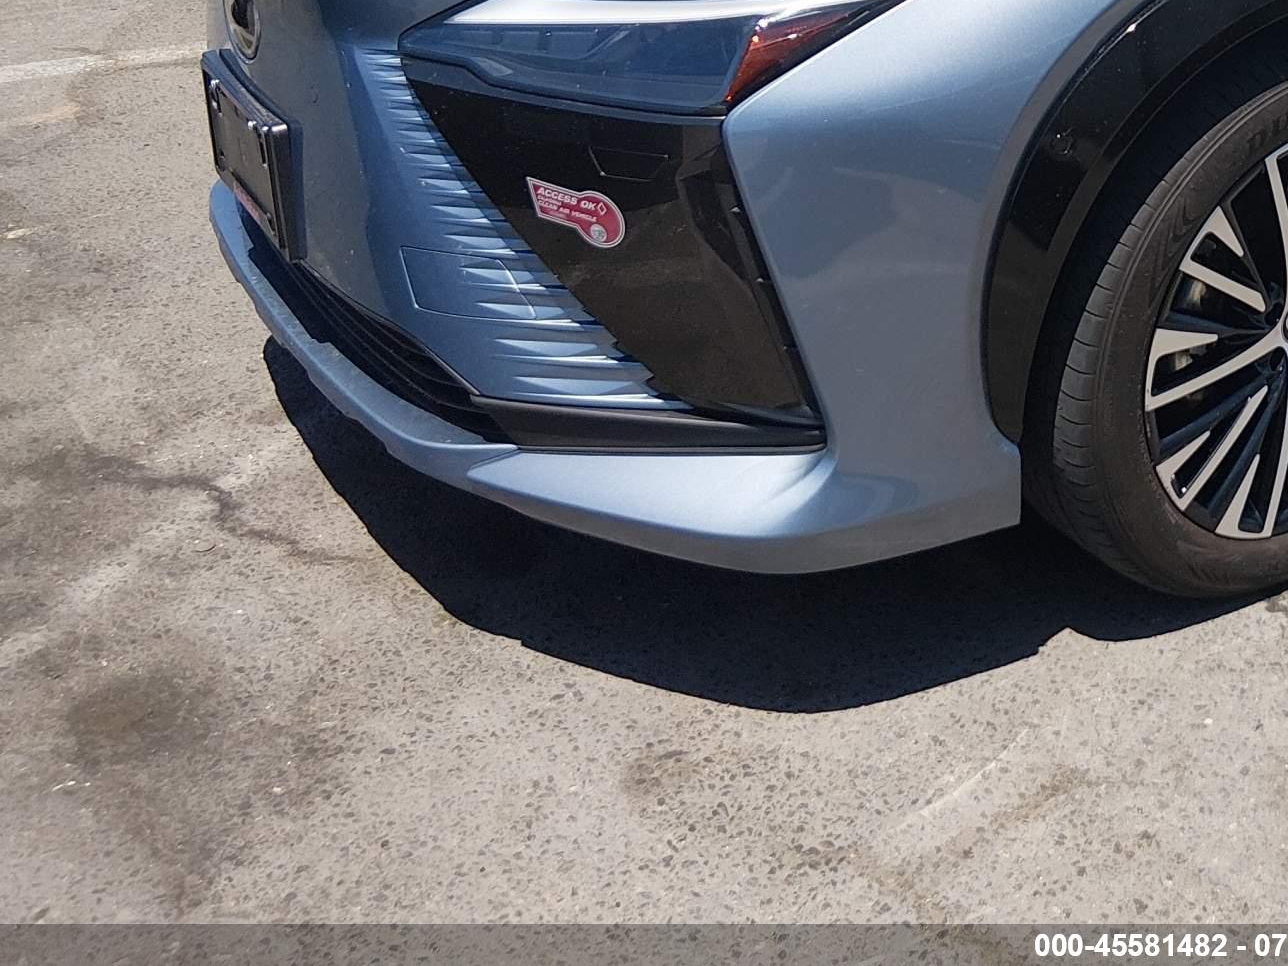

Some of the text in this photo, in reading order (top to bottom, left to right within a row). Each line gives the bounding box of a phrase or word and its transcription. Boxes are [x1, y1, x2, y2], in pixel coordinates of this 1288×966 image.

[537, 187, 597, 211] ACCESS OK
[537, 199, 558, 211] CLEAN
[558, 206, 570, 214] AIR
[571, 210, 598, 223] VEHICLE
